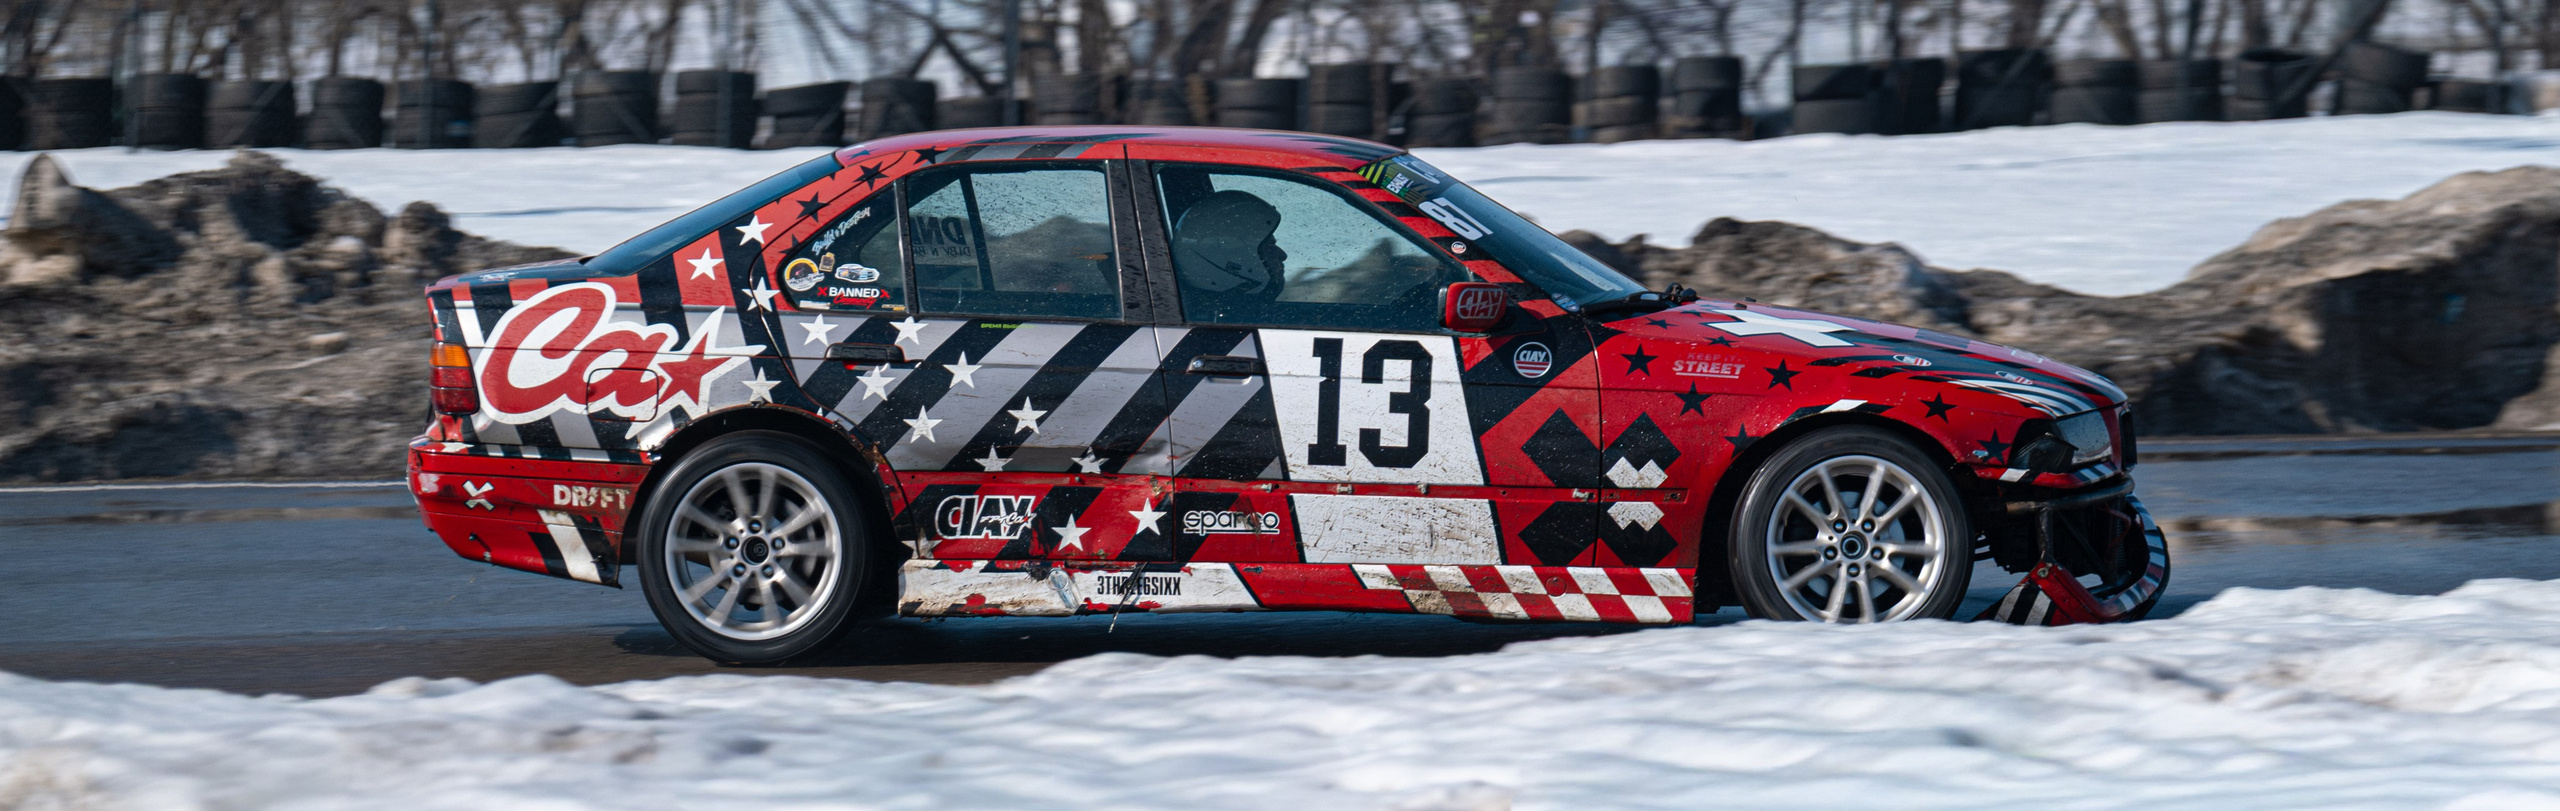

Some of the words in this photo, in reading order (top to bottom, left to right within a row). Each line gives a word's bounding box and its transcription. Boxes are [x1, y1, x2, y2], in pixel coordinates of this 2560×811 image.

[828, 286, 880, 298] BANNED
[1672, 359, 1746, 376] STREET
[1307, 337, 1434, 469] 13
